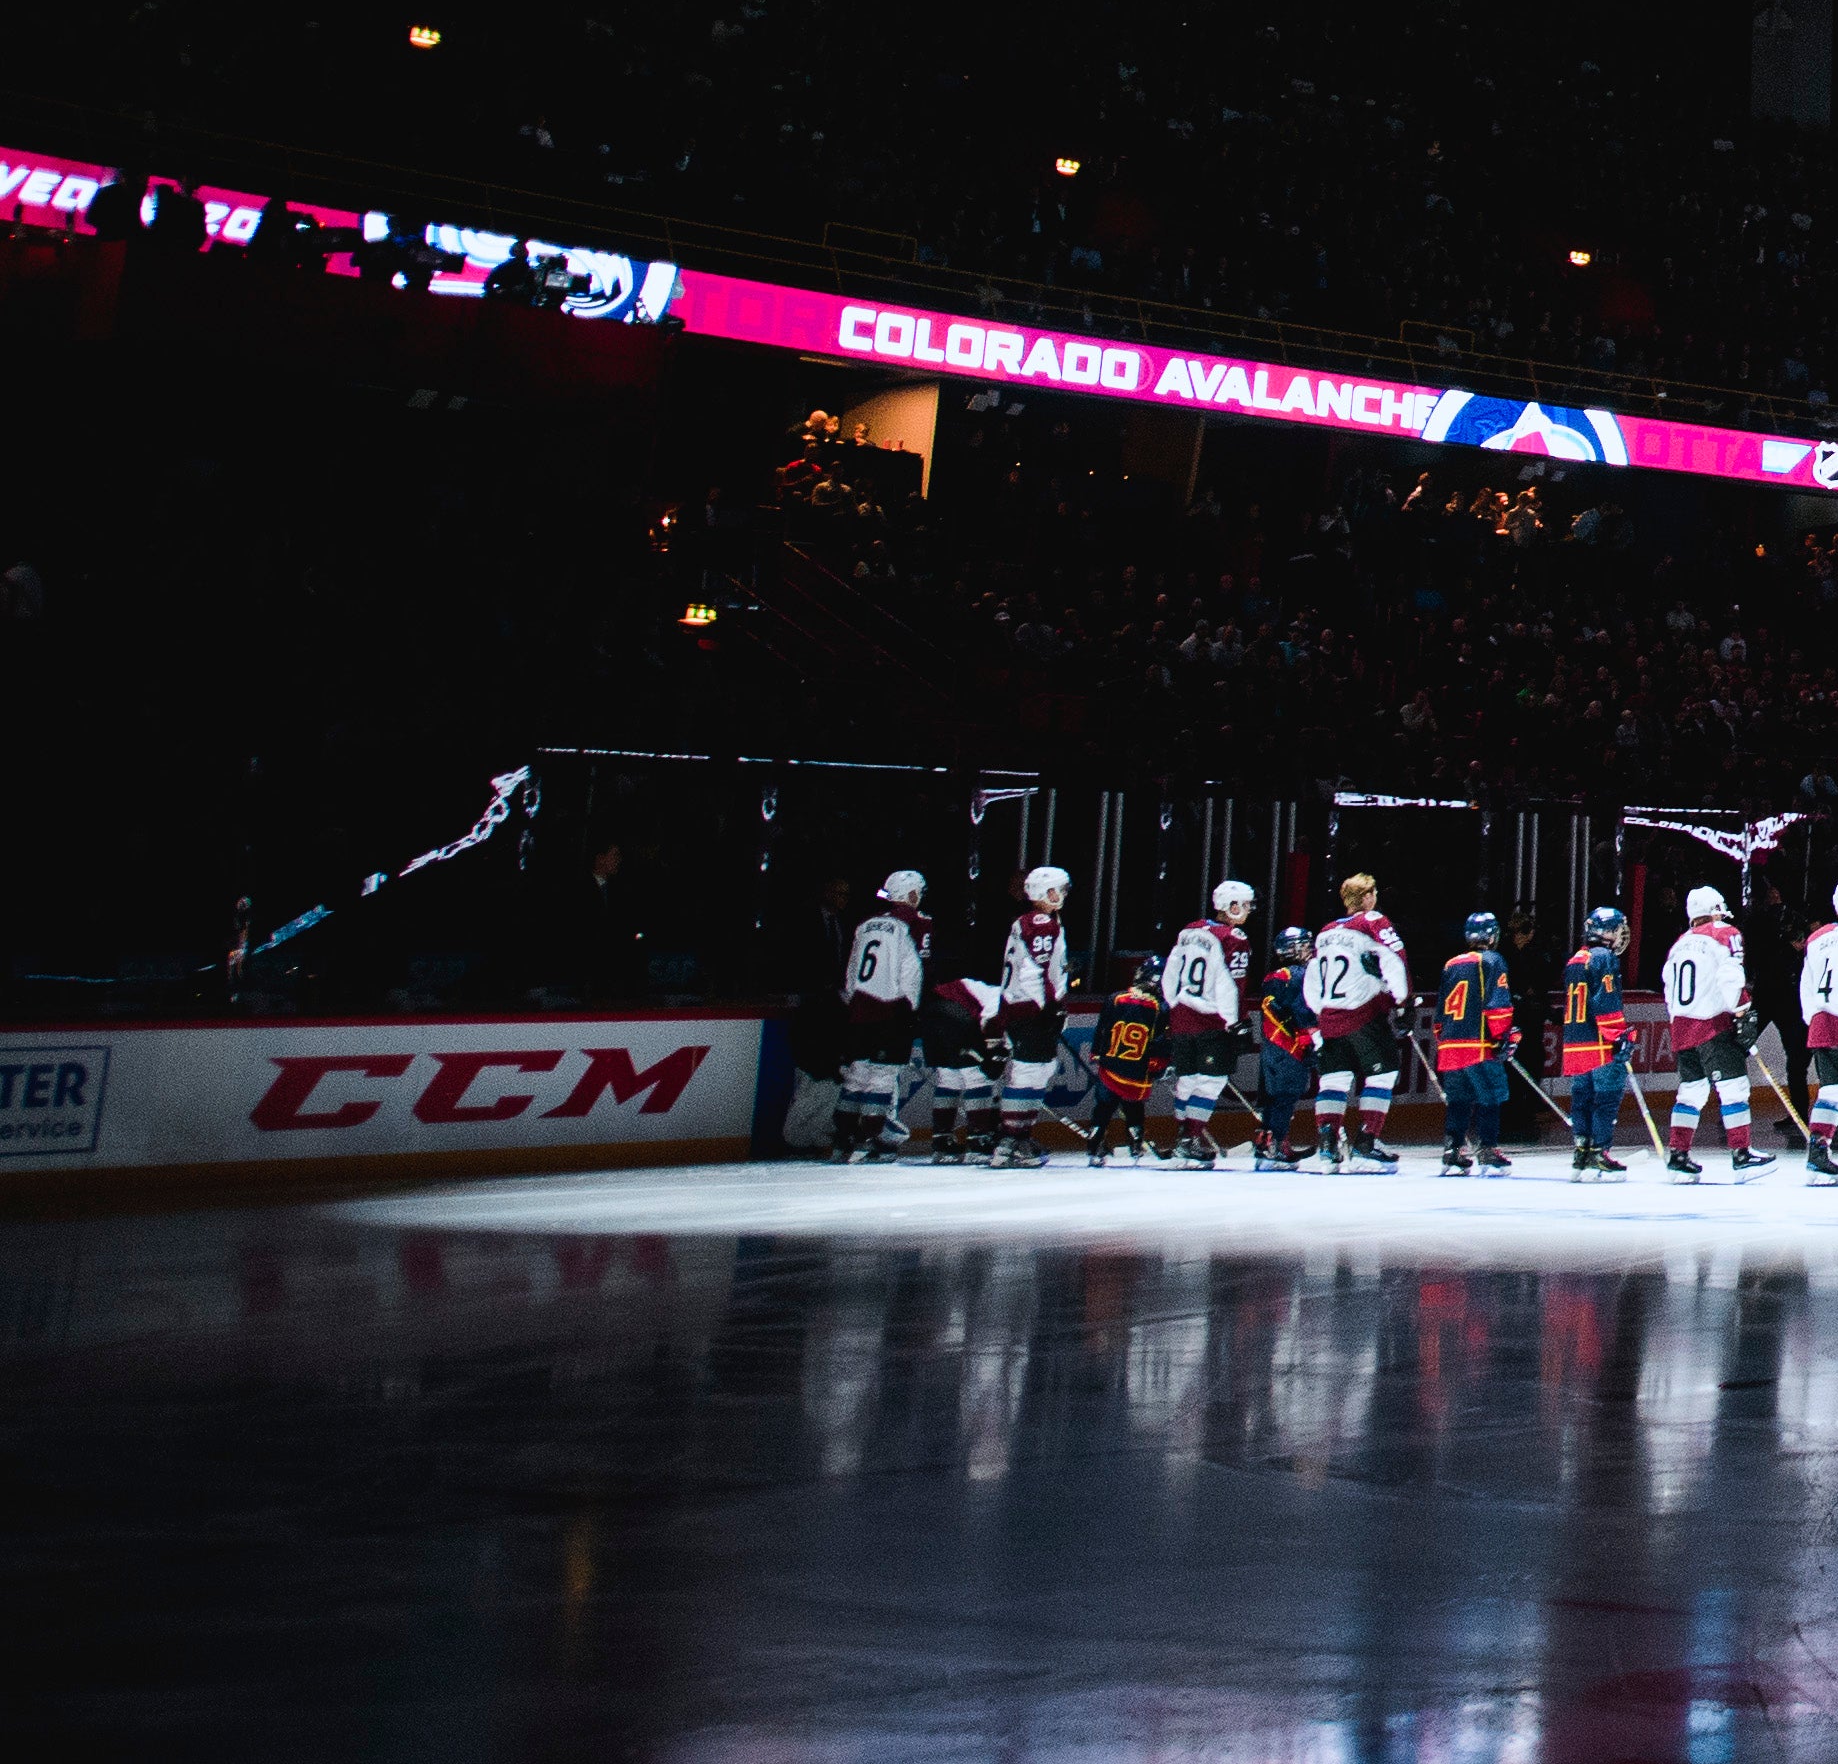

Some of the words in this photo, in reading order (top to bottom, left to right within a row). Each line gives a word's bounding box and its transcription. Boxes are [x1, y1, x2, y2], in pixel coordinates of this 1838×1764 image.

[837, 305, 1140, 391] COLORADO
[1153, 357, 1440, 431] AVALANCHE
[857, 939, 881, 983] 6
[1032, 935, 1054, 952] 96
[1229, 951, 1248, 969] 29
[1443, 979, 1469, 1022] 4
[1671, 959, 1697, 1007] 10
[1816, 957, 1834, 1004] 4
[1563, 981, 1589, 1024] 11
[1105, 1020, 1150, 1062] 19
[248, 1044, 713, 1132] CCM
